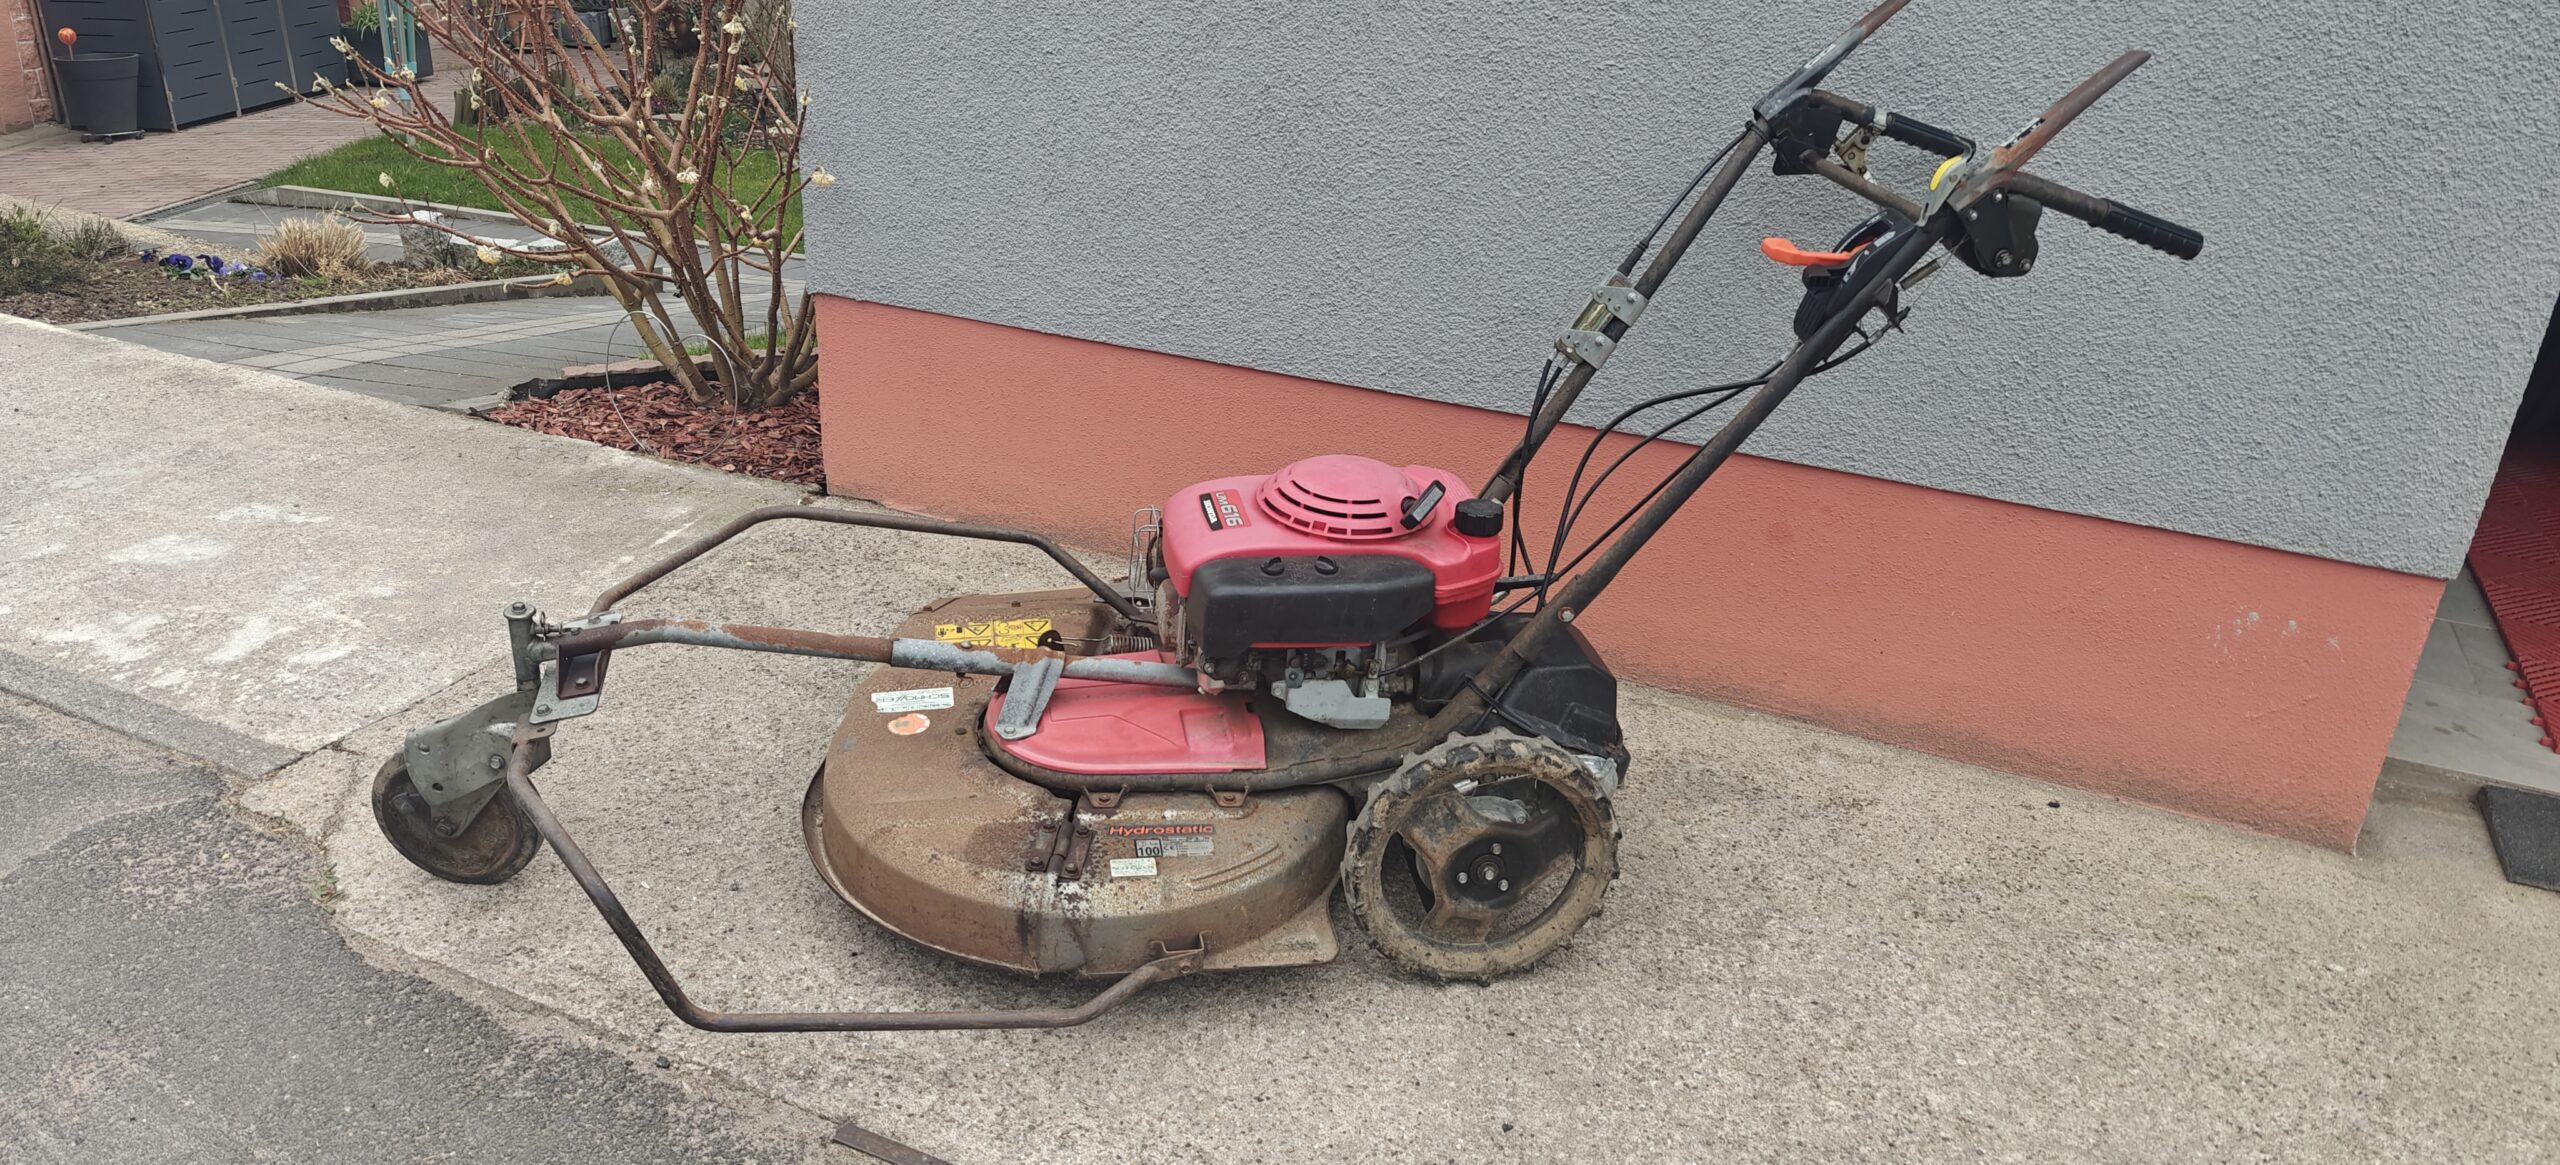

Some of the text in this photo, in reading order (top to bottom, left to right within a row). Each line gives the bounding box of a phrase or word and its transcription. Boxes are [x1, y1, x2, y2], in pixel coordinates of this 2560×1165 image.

[1203, 499, 1218, 524] HONDA
[1109, 825, 1213, 837] Hydrostatic
[1138, 846, 1160, 856] 100
